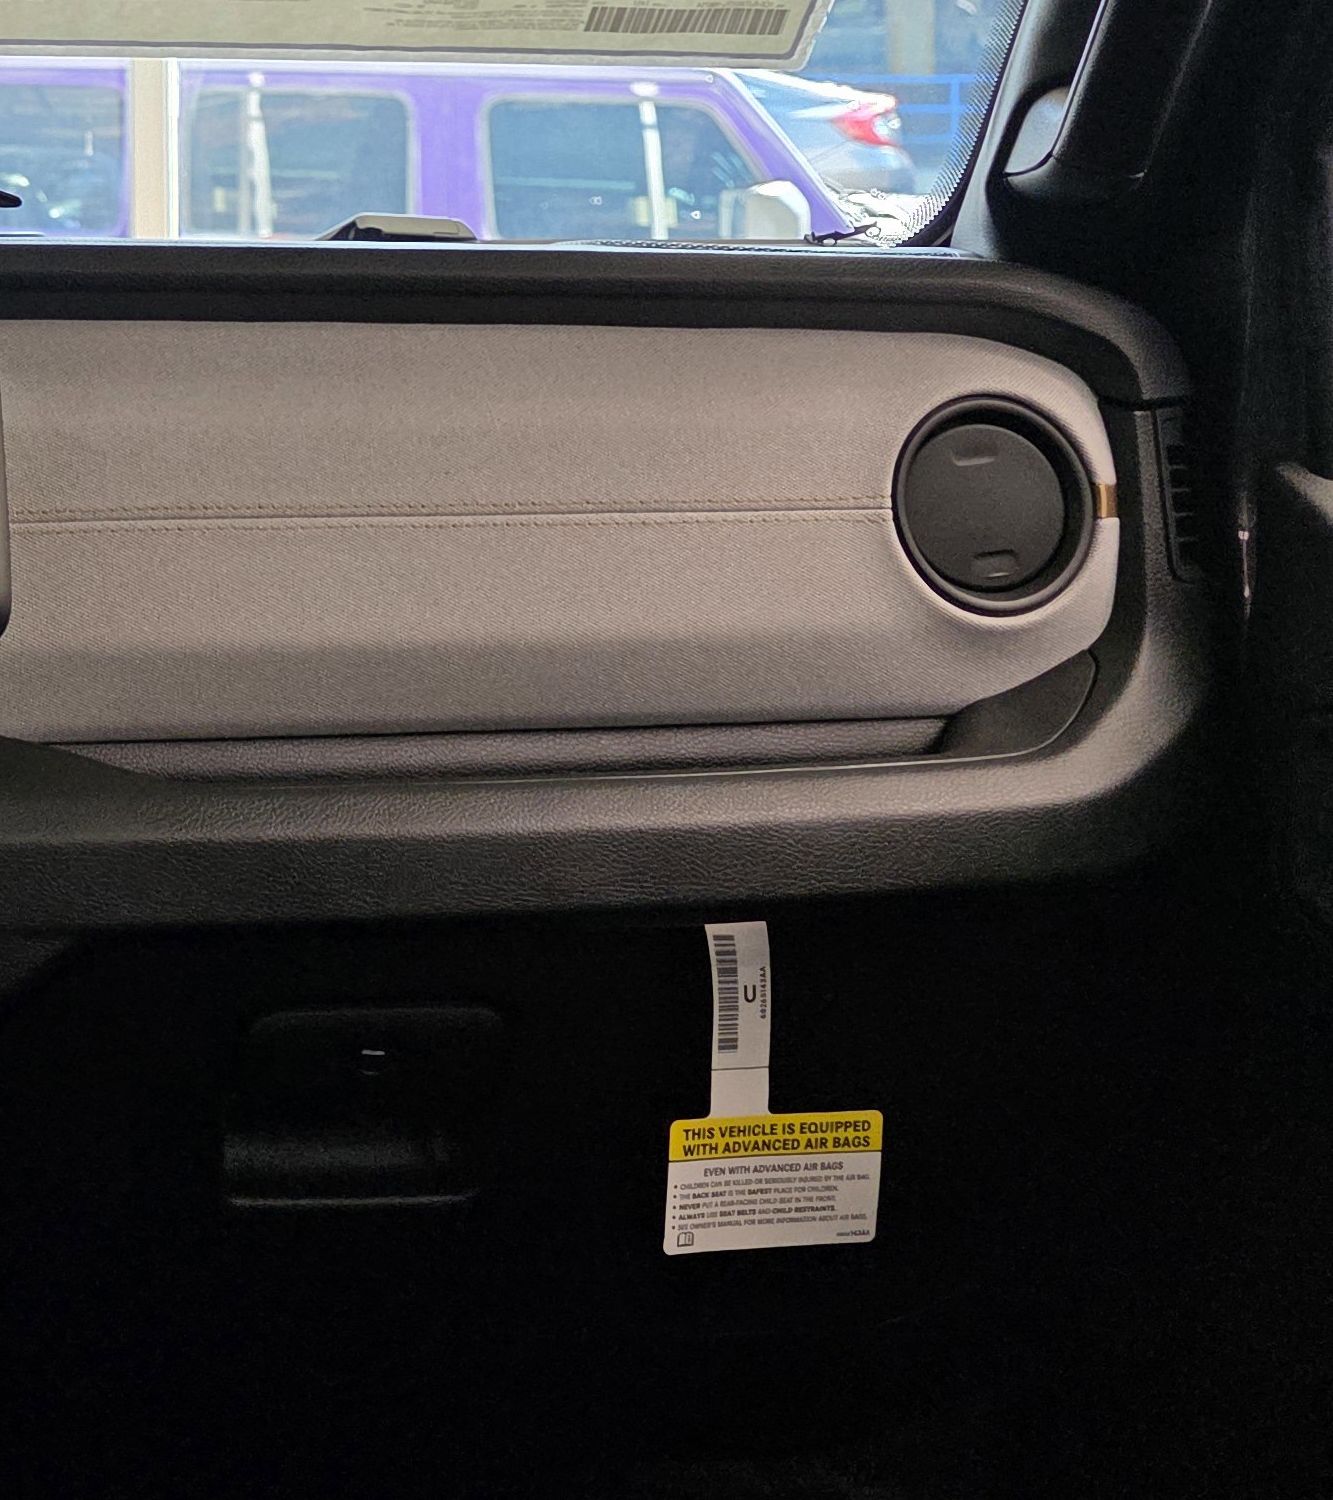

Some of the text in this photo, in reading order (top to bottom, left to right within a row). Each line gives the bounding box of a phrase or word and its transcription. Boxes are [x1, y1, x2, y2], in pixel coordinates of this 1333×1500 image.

[743, 984, 757, 1003] U
[682, 1119, 872, 1141] THIS VEHICLE IS EQUIPPED
[682, 1135, 871, 1157] WITH ADVANCED AIR BAGS
[703, 1161, 844, 1177] EVEN WITH ADVANCED AIR BAGS
